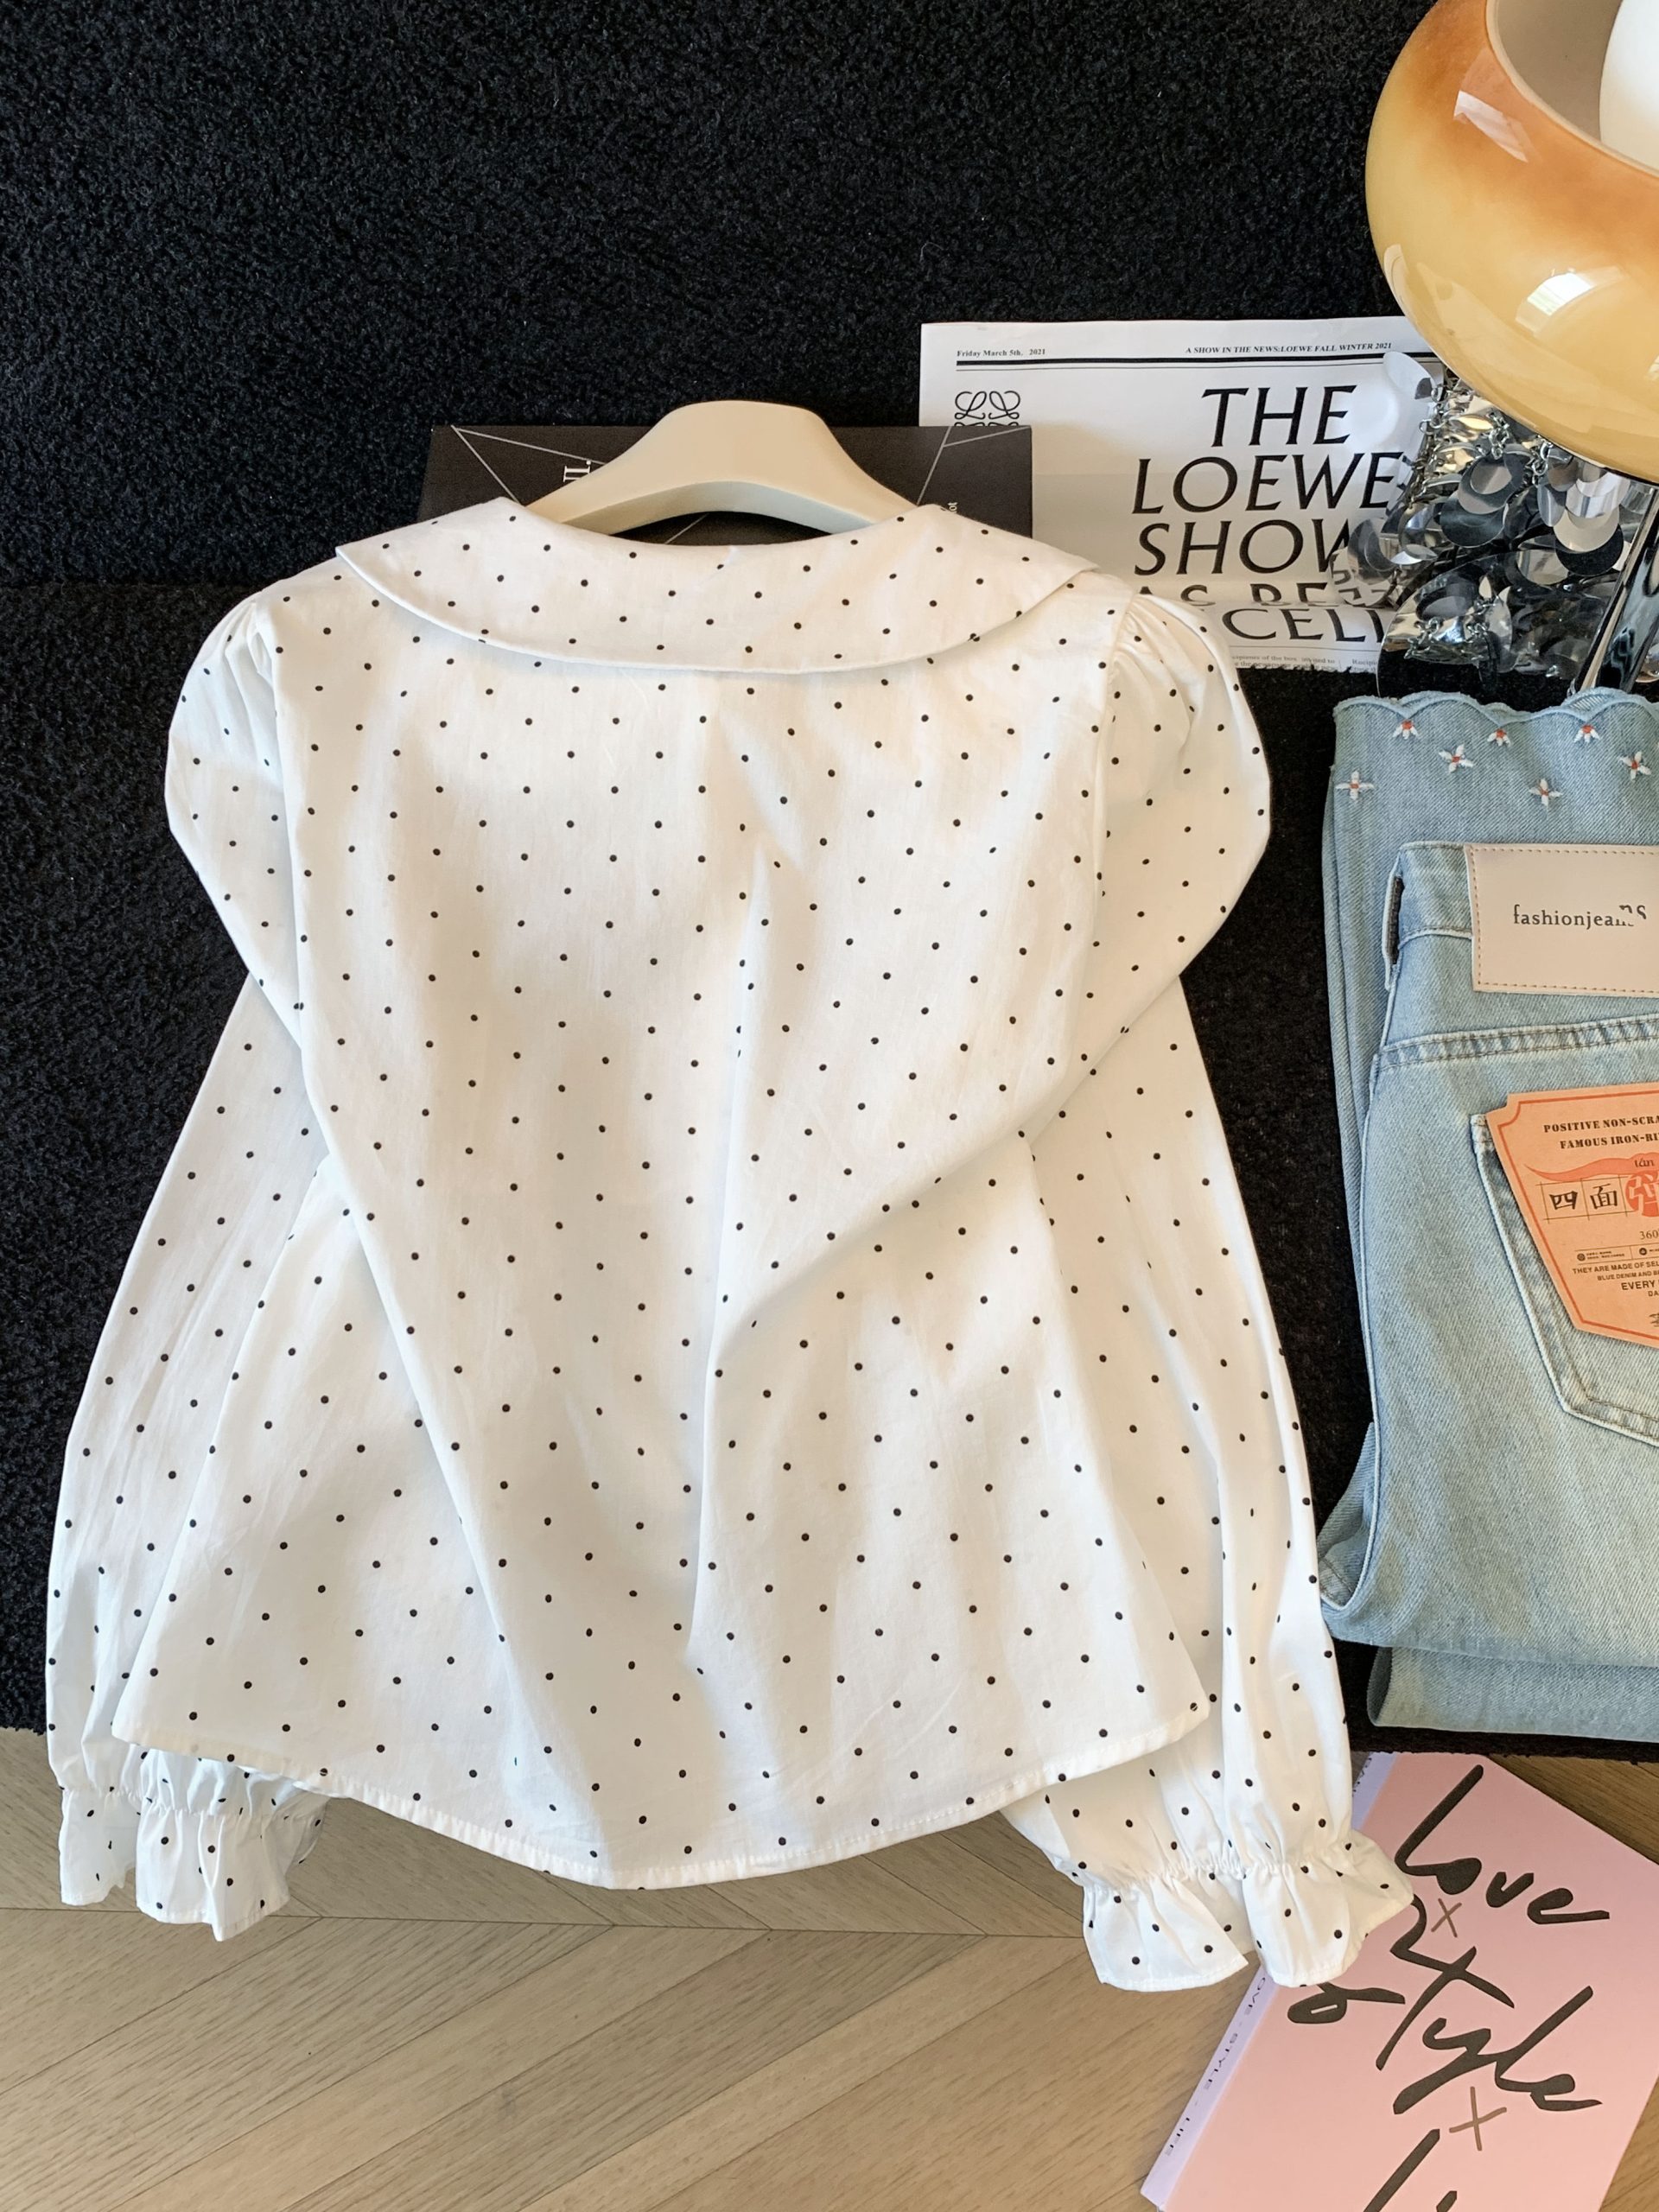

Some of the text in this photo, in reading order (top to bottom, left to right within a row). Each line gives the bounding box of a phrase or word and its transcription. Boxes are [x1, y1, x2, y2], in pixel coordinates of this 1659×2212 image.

[957, 350, 982, 359] Friday
[1201, 385, 1357, 448] THE
[1132, 451, 1404, 514] LOEWE
[1544, 1121, 1600, 1134] POSITIVE
[1560, 1132, 1659, 1150] FAMOUS IRON-RI
[1639, 1229, 1659, 1241] 360
[1611, 1262, 1633, 1271] MADE
[1621, 1280, 1656, 1290] EVERY
